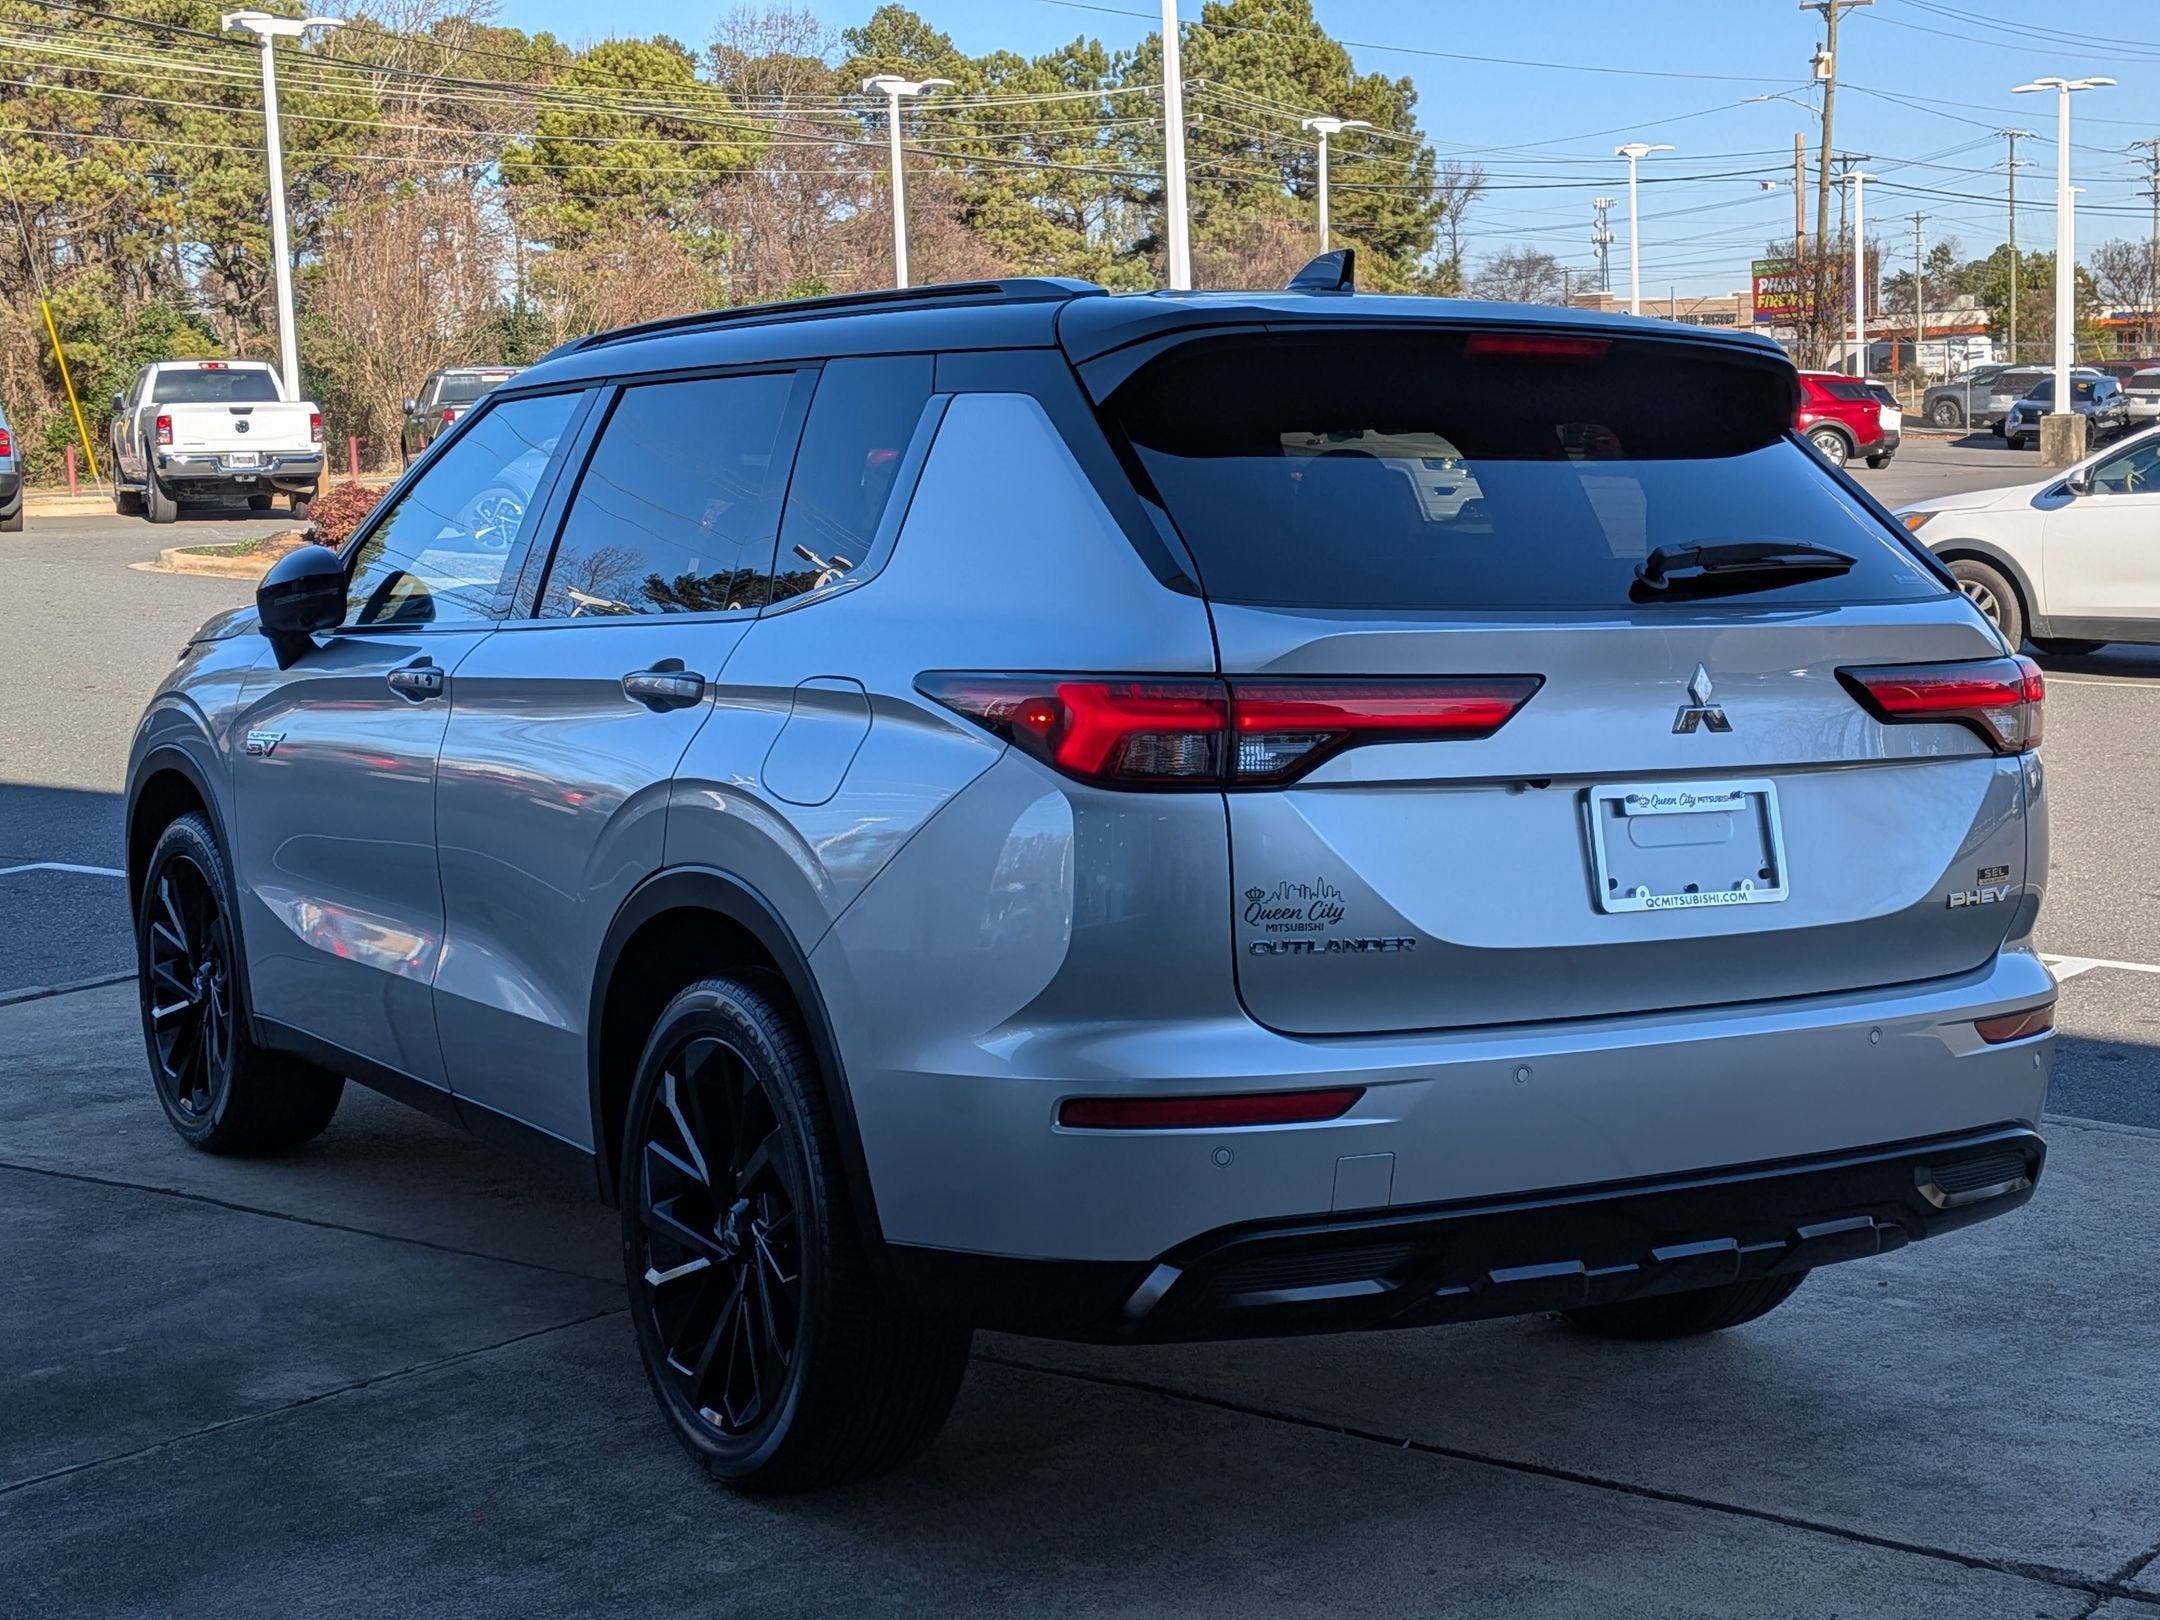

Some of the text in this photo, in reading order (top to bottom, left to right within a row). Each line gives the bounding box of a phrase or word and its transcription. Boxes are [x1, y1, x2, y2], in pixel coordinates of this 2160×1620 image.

[1650, 793, 1678, 809] Queen
[1679, 792, 1697, 807] City
[1984, 867, 2005, 878] SEL
[1646, 892, 1748, 908] QCMITSUBISHI.COM
[1946, 884, 2010, 909] PHEV
[1244, 900, 1345, 927] Queen City
[1265, 922, 1324, 932] MITSUBISHI
[1249, 936, 1416, 955] OUTLANDER
